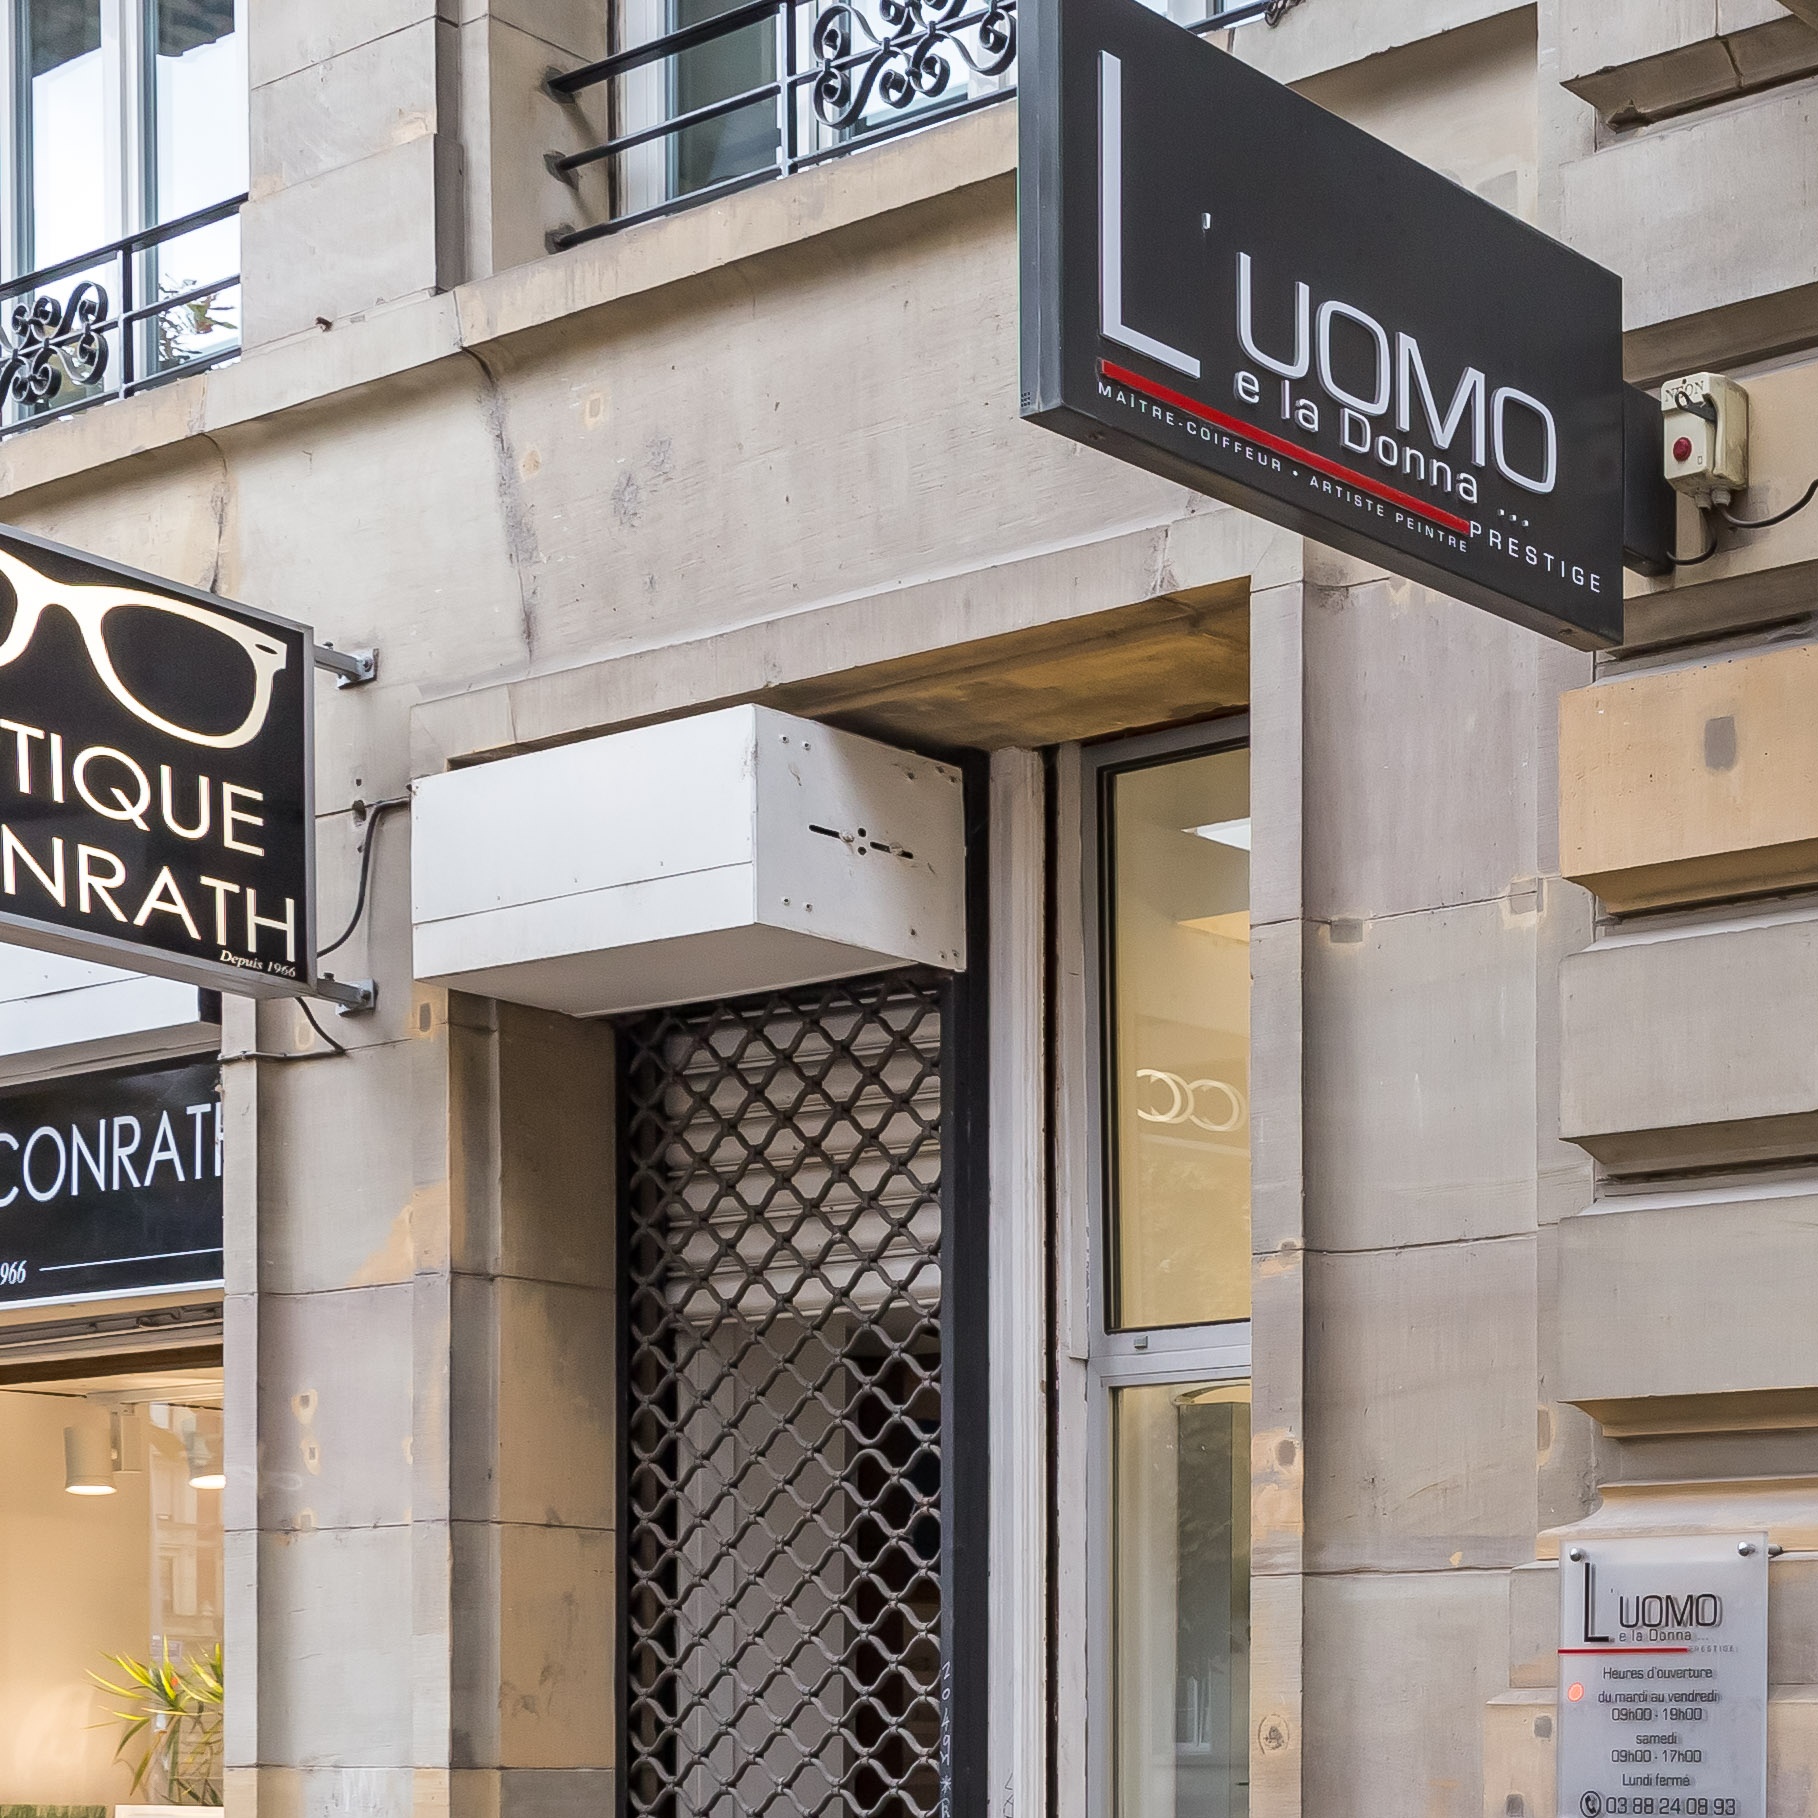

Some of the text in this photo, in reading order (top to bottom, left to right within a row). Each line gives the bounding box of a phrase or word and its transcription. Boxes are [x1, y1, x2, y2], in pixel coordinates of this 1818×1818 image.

[1098, 49, 1558, 495] L'UOMO
[1234, 369, 1261, 404] e
[1281, 378, 1319, 433] la
[1310, 475, 1385, 518] ARTISTE
[1395, 511, 1468, 553] PEINTRE
[1469, 519, 1602, 594] PRESTIGE
[0, 717, 266, 857] TIQUE
[1, 822, 296, 963] NRATH
[220, 949, 296, 978] Depuis 1966
[1584, 1562, 1718, 1643] L'UOMO
[1619, 1632, 1627, 1642] e
[1631, 1629, 1643, 1642] la
[1603, 1666, 1713, 1680] Heures d'ouverture
[1598, 1689, 1718, 1703] du mardi au vendredi
[1611, 1707, 1652, 1721] 09h00
[1663, 1707, 1703, 1721] 19h00
[1635, 1732, 1677, 1745] samedi
[1611, 1749, 1652, 1763] 09h00
[1662, 1749, 1702, 1763] 17h00
[1622, 1773, 1691, 1787] Lundi fermé
[1606, 1796, 1736, 1816] 03 88 24 08 93
